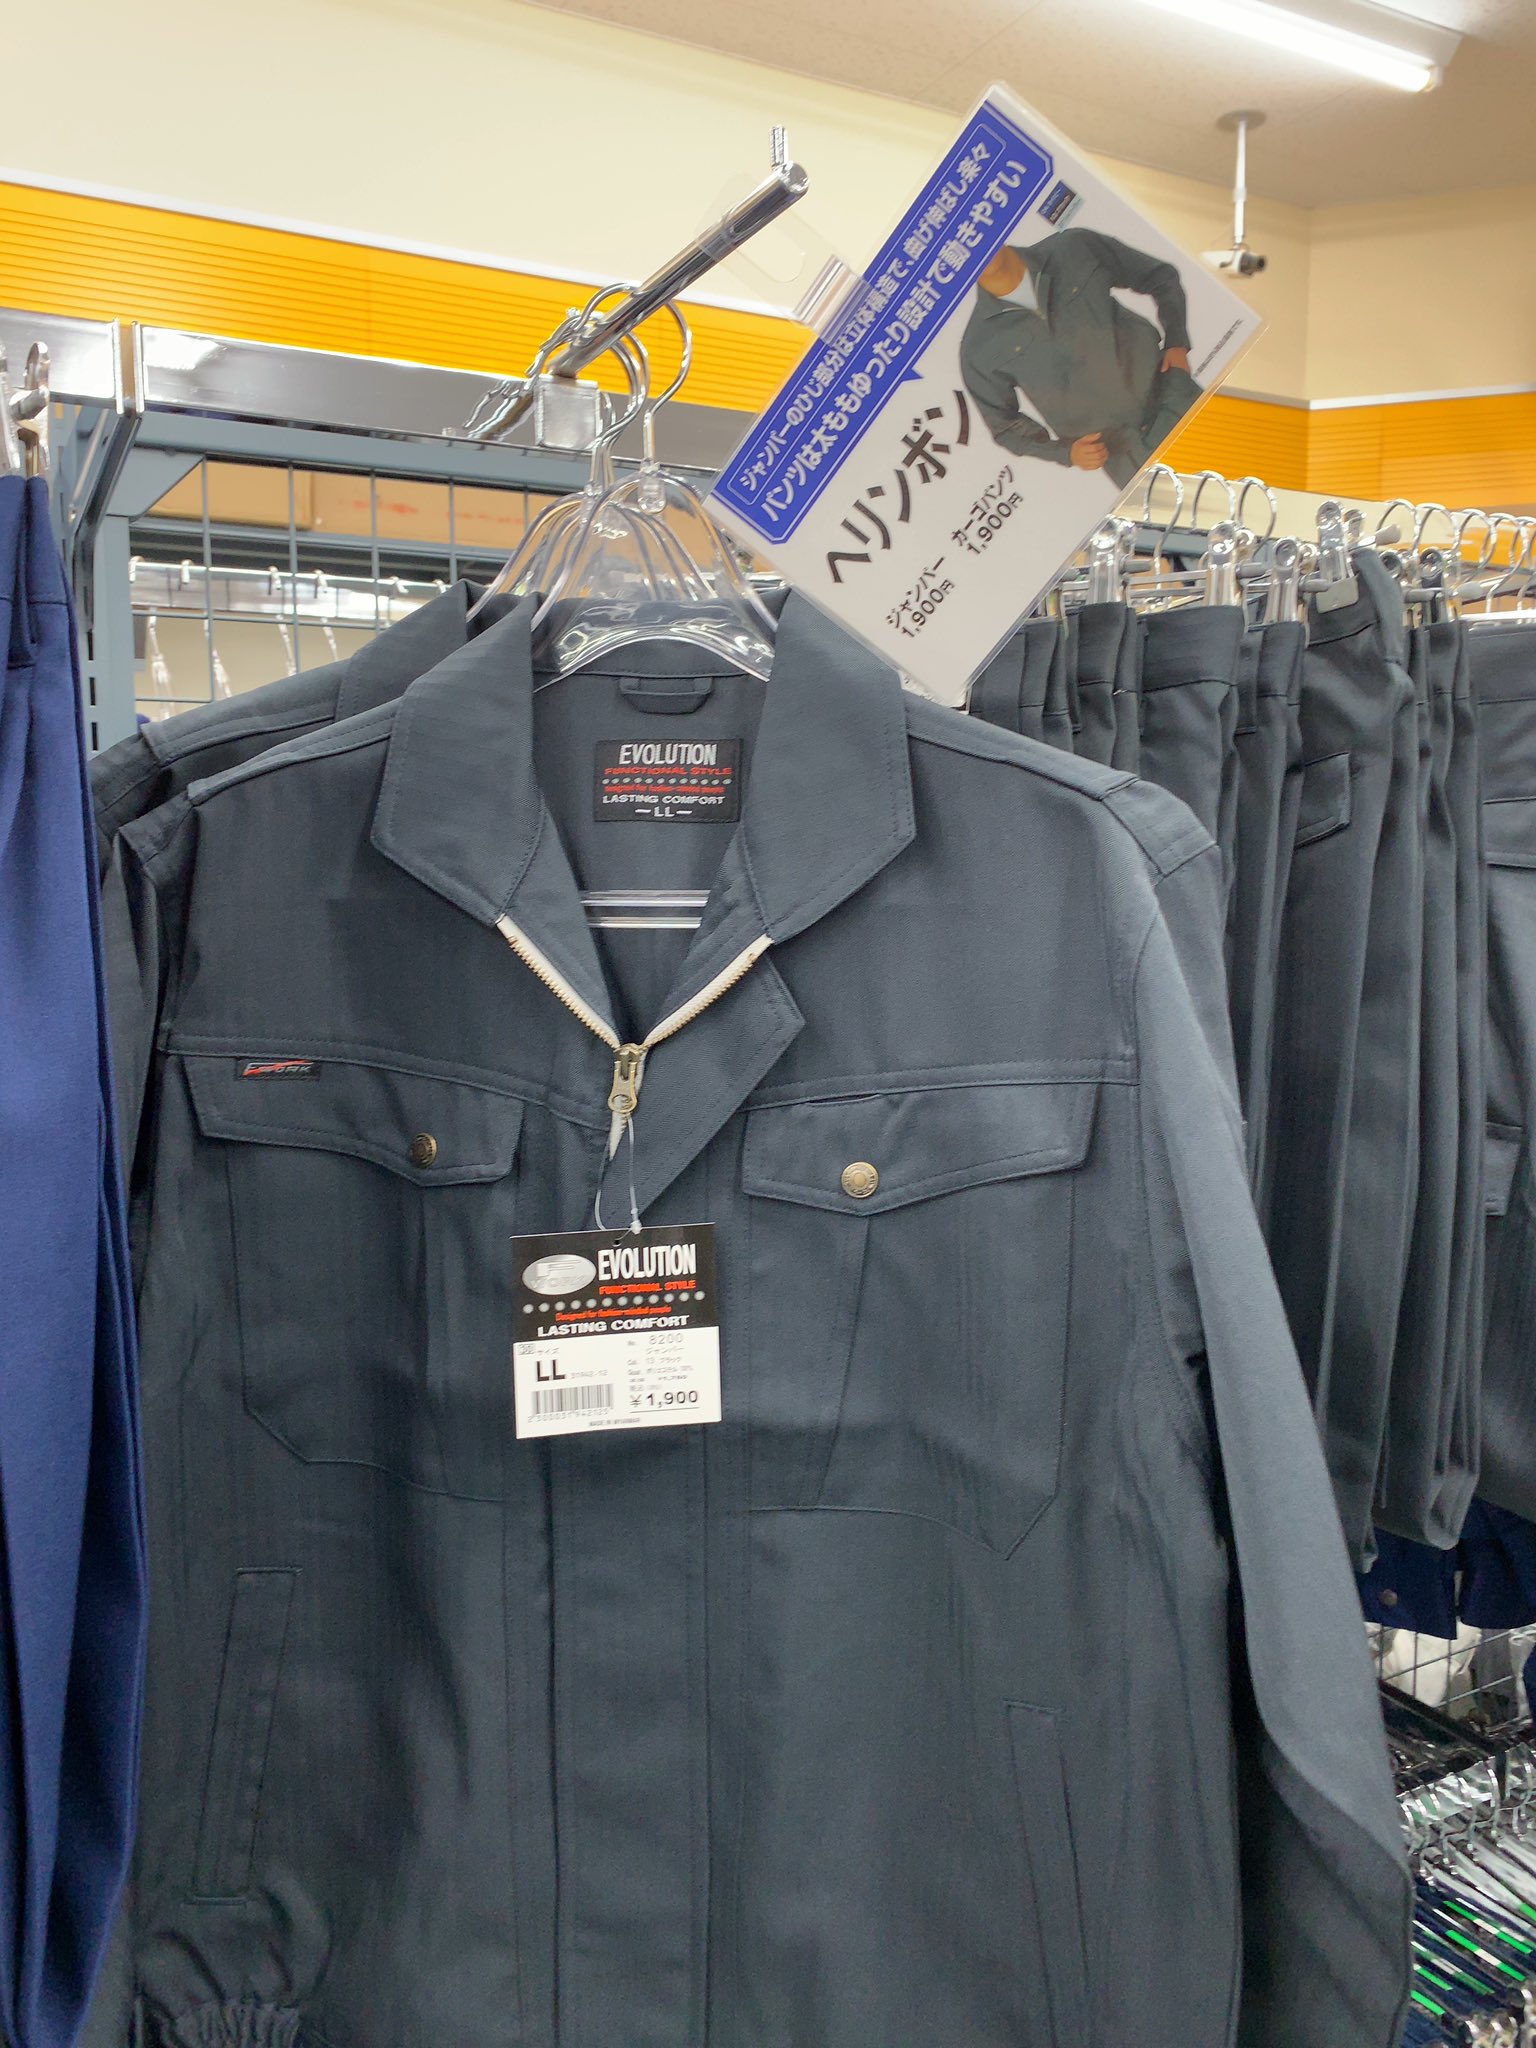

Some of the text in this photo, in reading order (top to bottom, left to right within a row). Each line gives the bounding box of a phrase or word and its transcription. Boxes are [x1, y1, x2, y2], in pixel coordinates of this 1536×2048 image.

[761, 160, 1027, 521] パンツは太ももゆったり設計で動きやすい
[827, 390, 970, 583] ヘリンボン
[952, 465, 1014, 546] カーゴパンツ
[967, 492, 1023, 555] 1,900円
[902, 579, 955, 638] 1,900円
[618, 743, 718, 766] EVOLUTION
[604, 767, 732, 776] FUNCTIONAL STYLE
[602, 794, 726, 805] LASTING COMFORT
[597, 1243, 697, 1281] EVOLUTION
[664, 1280, 696, 1291] STYLE
[537, 1314, 690, 1338] LASTING COMFORT
[648, 1332, 684, 1345] 8200
[536, 1359, 566, 1382] LL
[630, 1390, 698, 1409] ¥1,900
